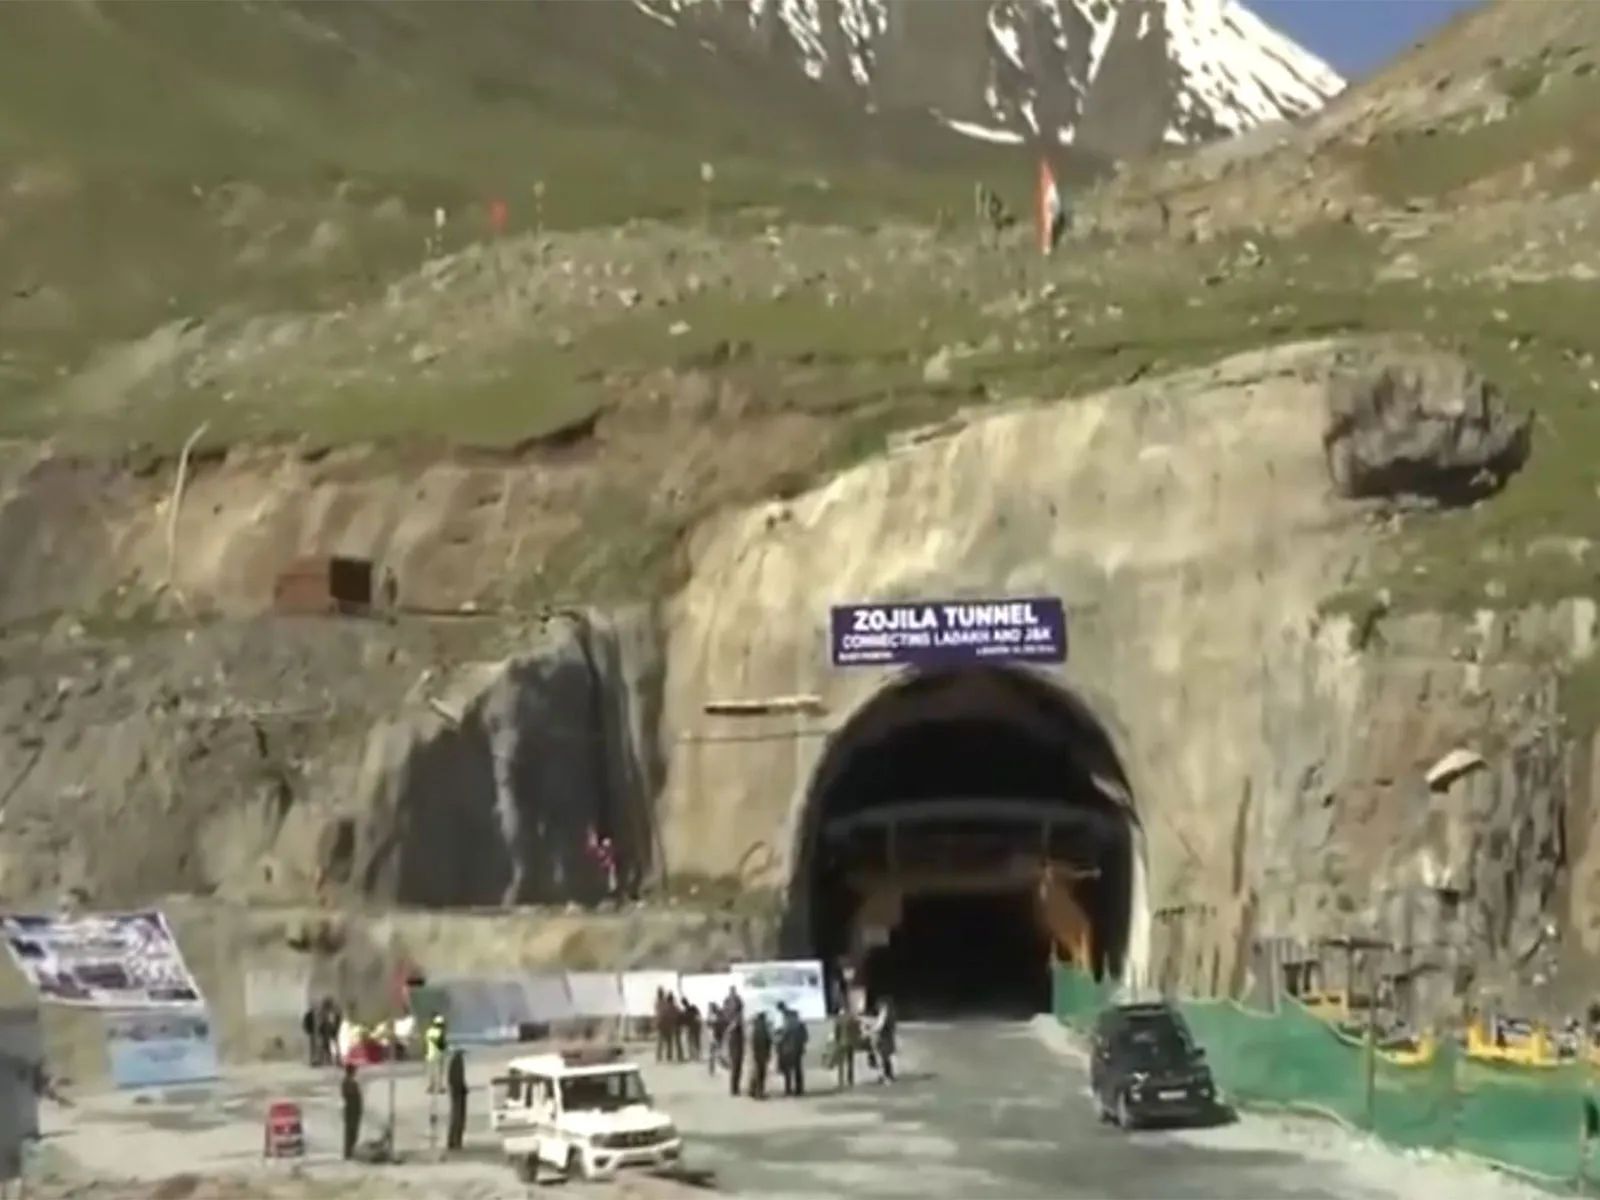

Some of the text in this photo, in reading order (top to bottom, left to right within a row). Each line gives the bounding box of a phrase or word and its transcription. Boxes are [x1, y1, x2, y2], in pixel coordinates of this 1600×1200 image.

[853, 603, 1038, 632] ZOJILA TUNNEL
[993, 628, 1020, 642] AND
